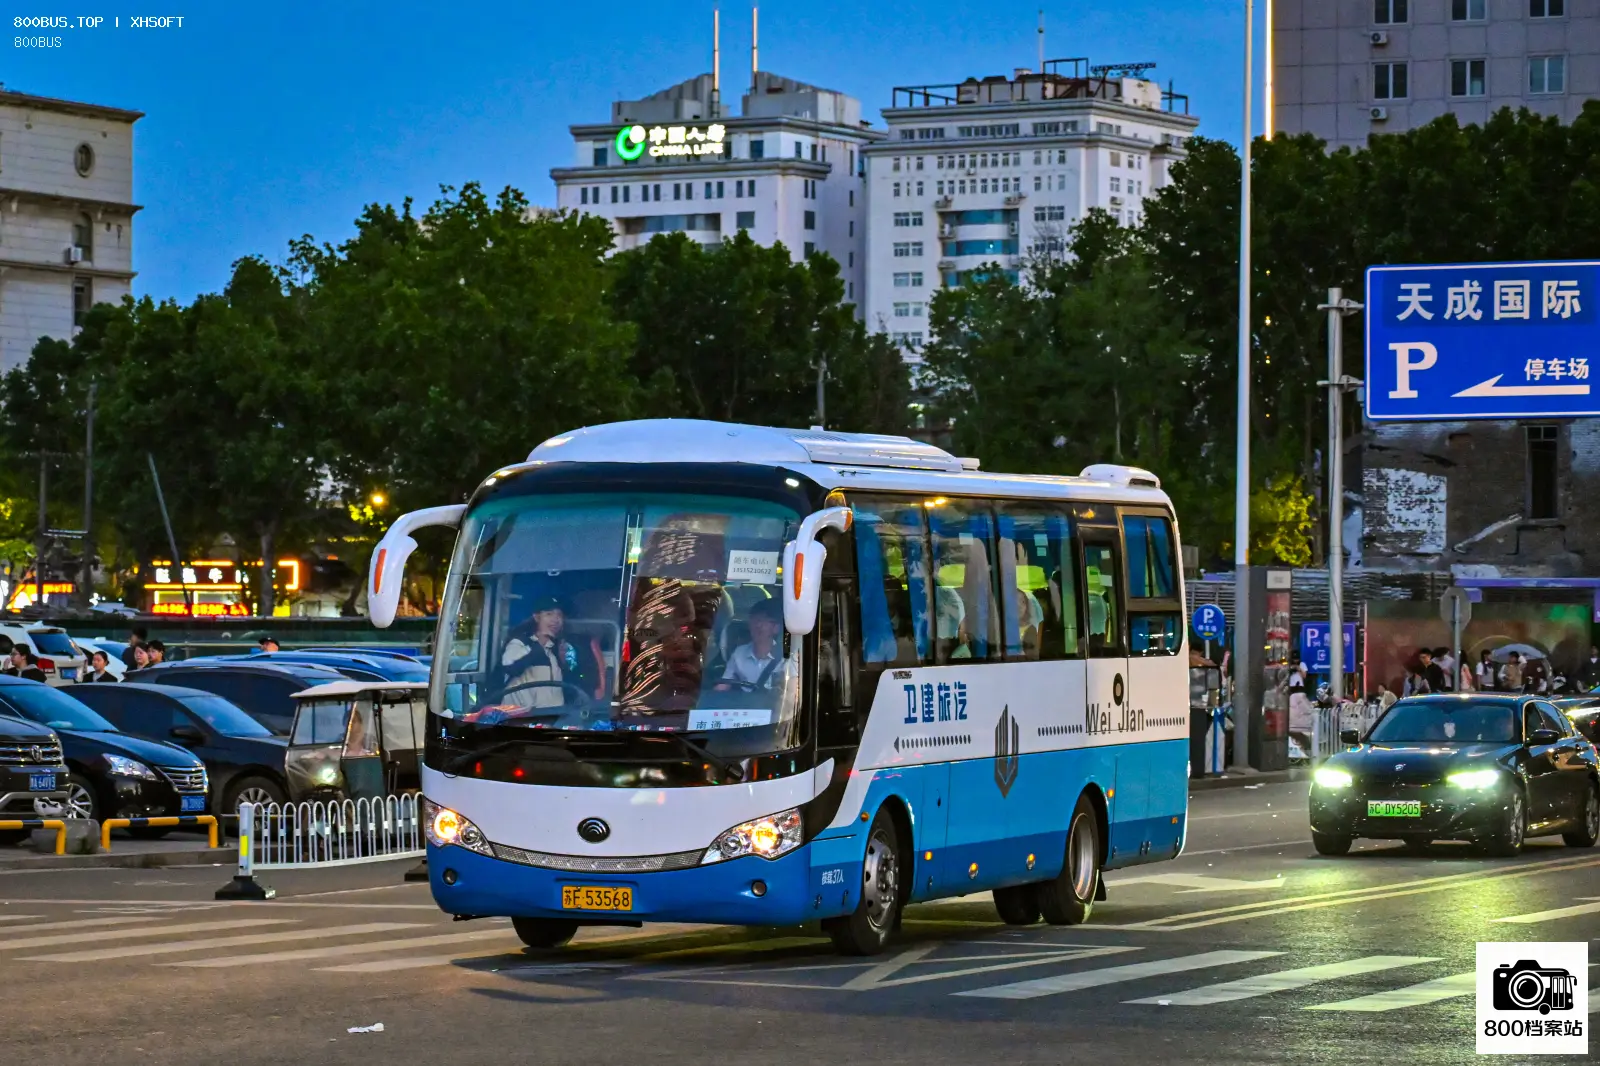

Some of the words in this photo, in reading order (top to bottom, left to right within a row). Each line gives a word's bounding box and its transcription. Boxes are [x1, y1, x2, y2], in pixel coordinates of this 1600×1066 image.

[1396, 279, 1582, 321] 天成国际
[1388, 341, 1438, 399] P
[1524, 358, 1590, 381] 停车场
[1203, 608, 1215, 624] P
[1306, 628, 1319, 647] P
[903, 680, 968, 724] 卫建旅汽
[696, 720, 722, 729] 南通
[1086, 701, 1111, 736] Wei
[1117, 700, 1145, 733] Jian
